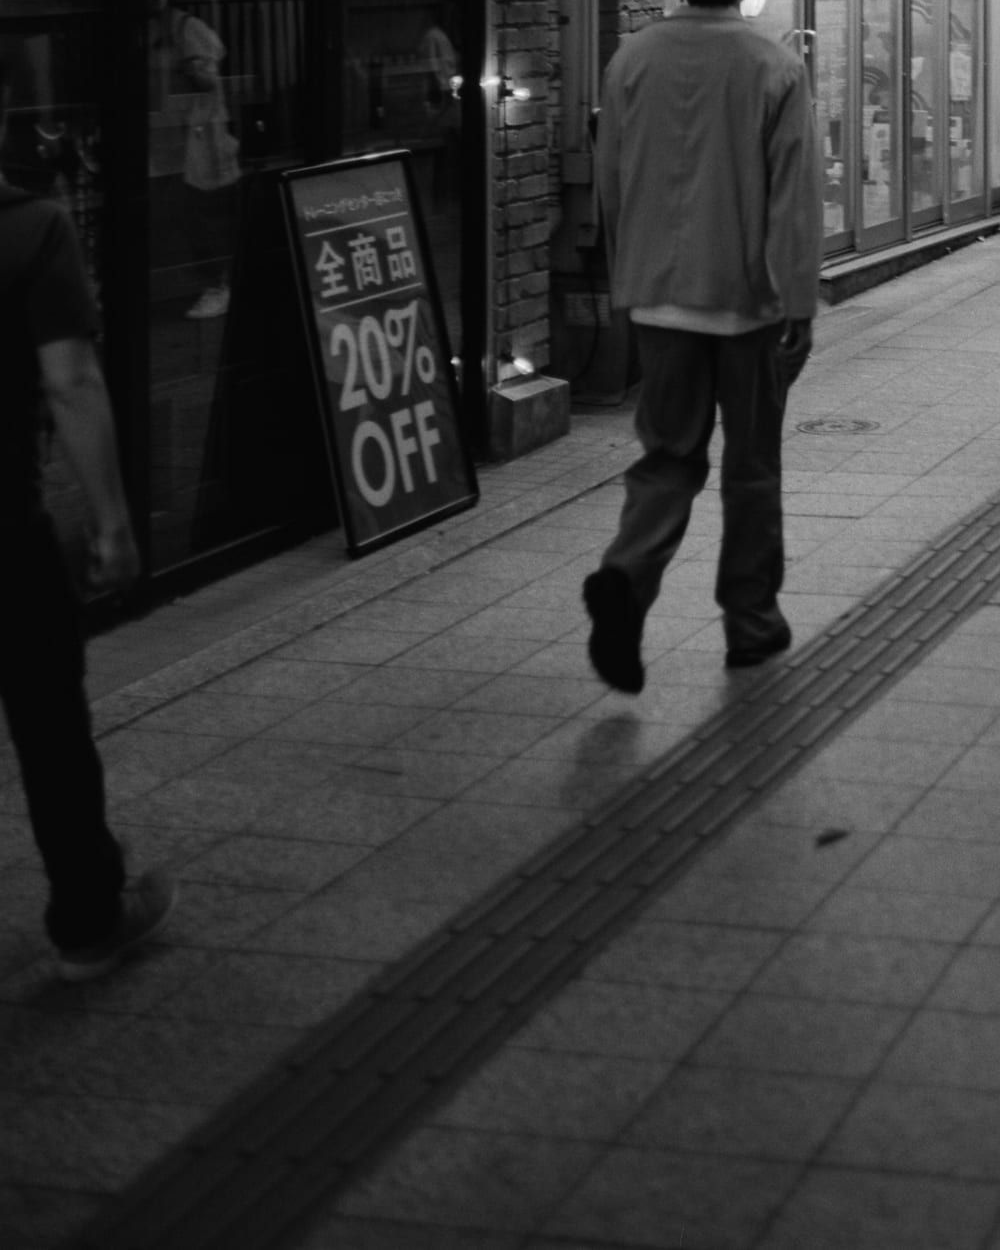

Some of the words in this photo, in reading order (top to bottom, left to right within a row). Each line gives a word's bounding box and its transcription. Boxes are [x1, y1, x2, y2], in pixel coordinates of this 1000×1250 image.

[314, 225, 417, 299] 全商品
[330, 299, 436, 412] 20%
[351, 400, 440, 508] OFF
